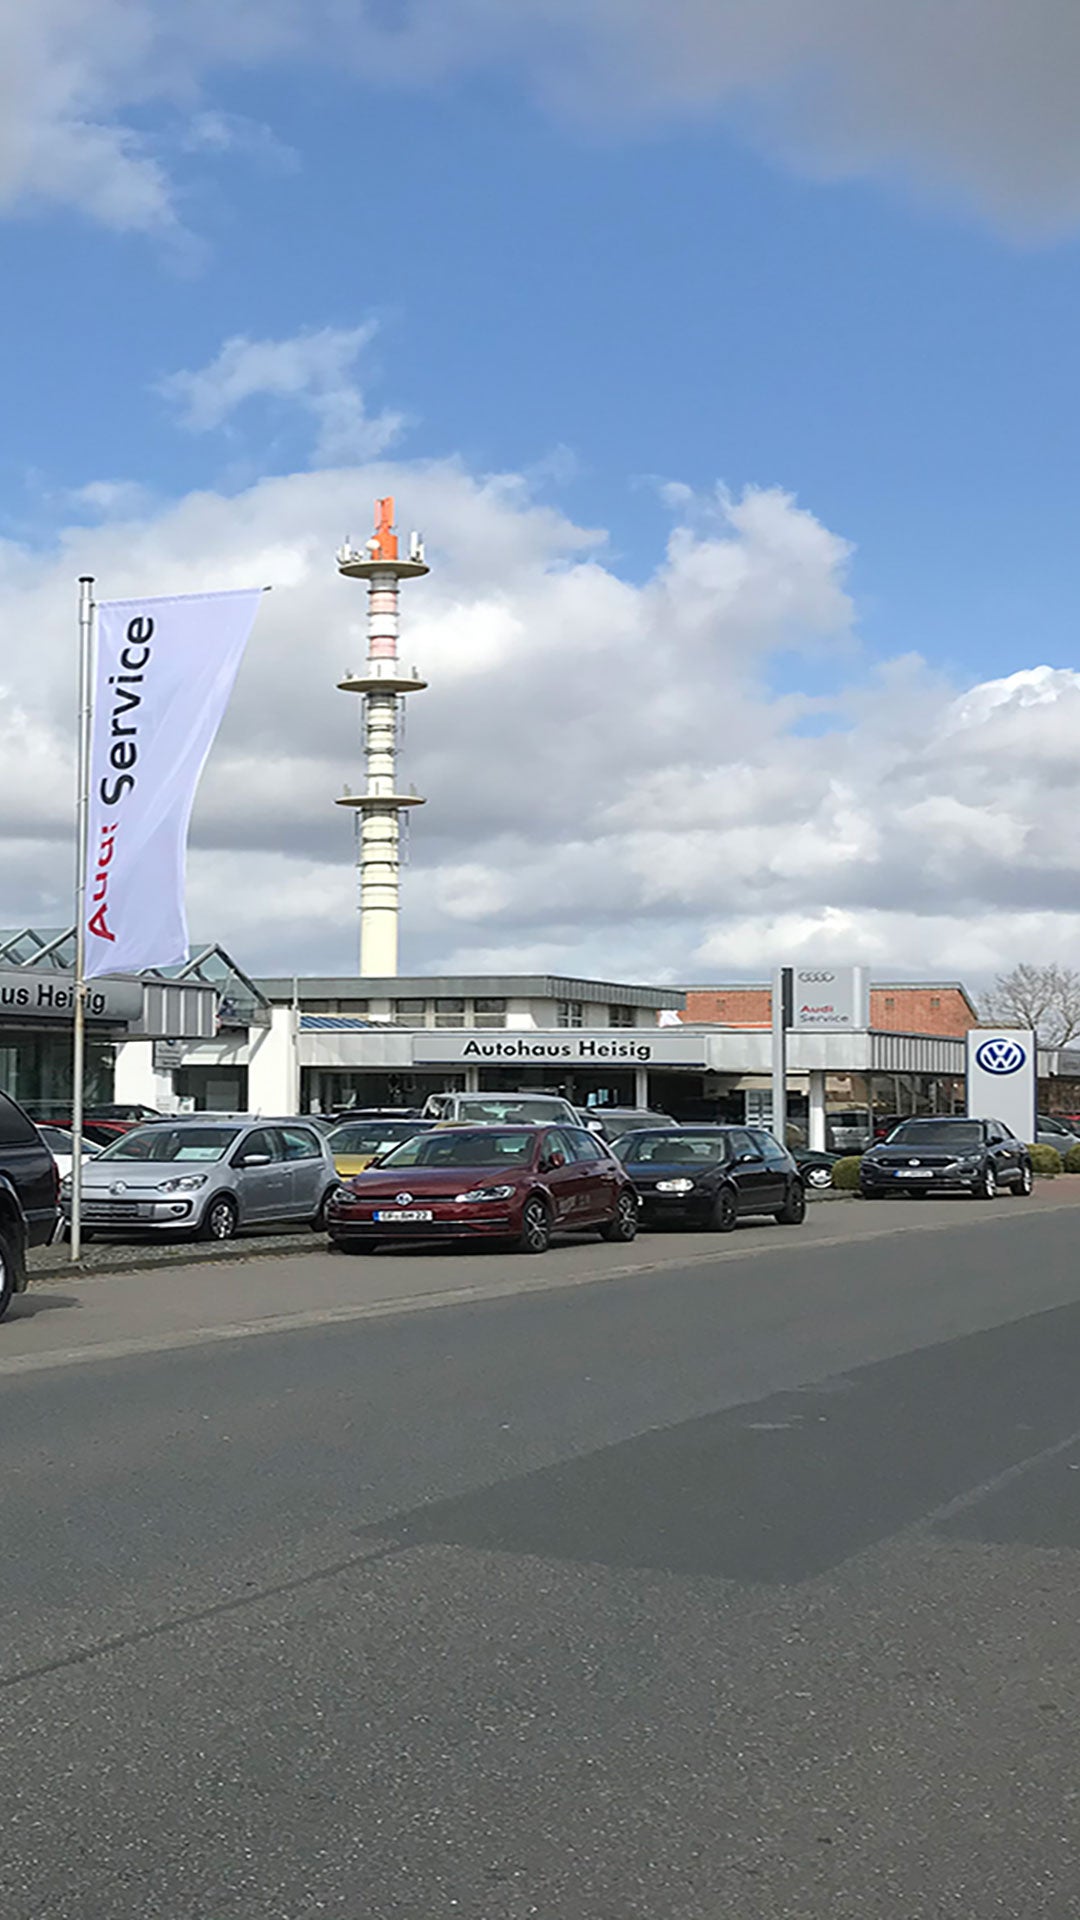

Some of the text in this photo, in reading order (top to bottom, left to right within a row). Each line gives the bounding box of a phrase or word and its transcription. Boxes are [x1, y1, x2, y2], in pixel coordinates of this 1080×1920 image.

[100, 616, 154, 806] Service
[37, 984, 105, 1015] Heiig
[800, 1005, 834, 1014] Audi
[800, 1013, 849, 1023] Service
[463, 1040, 651, 1061] Autohaus Heisig
